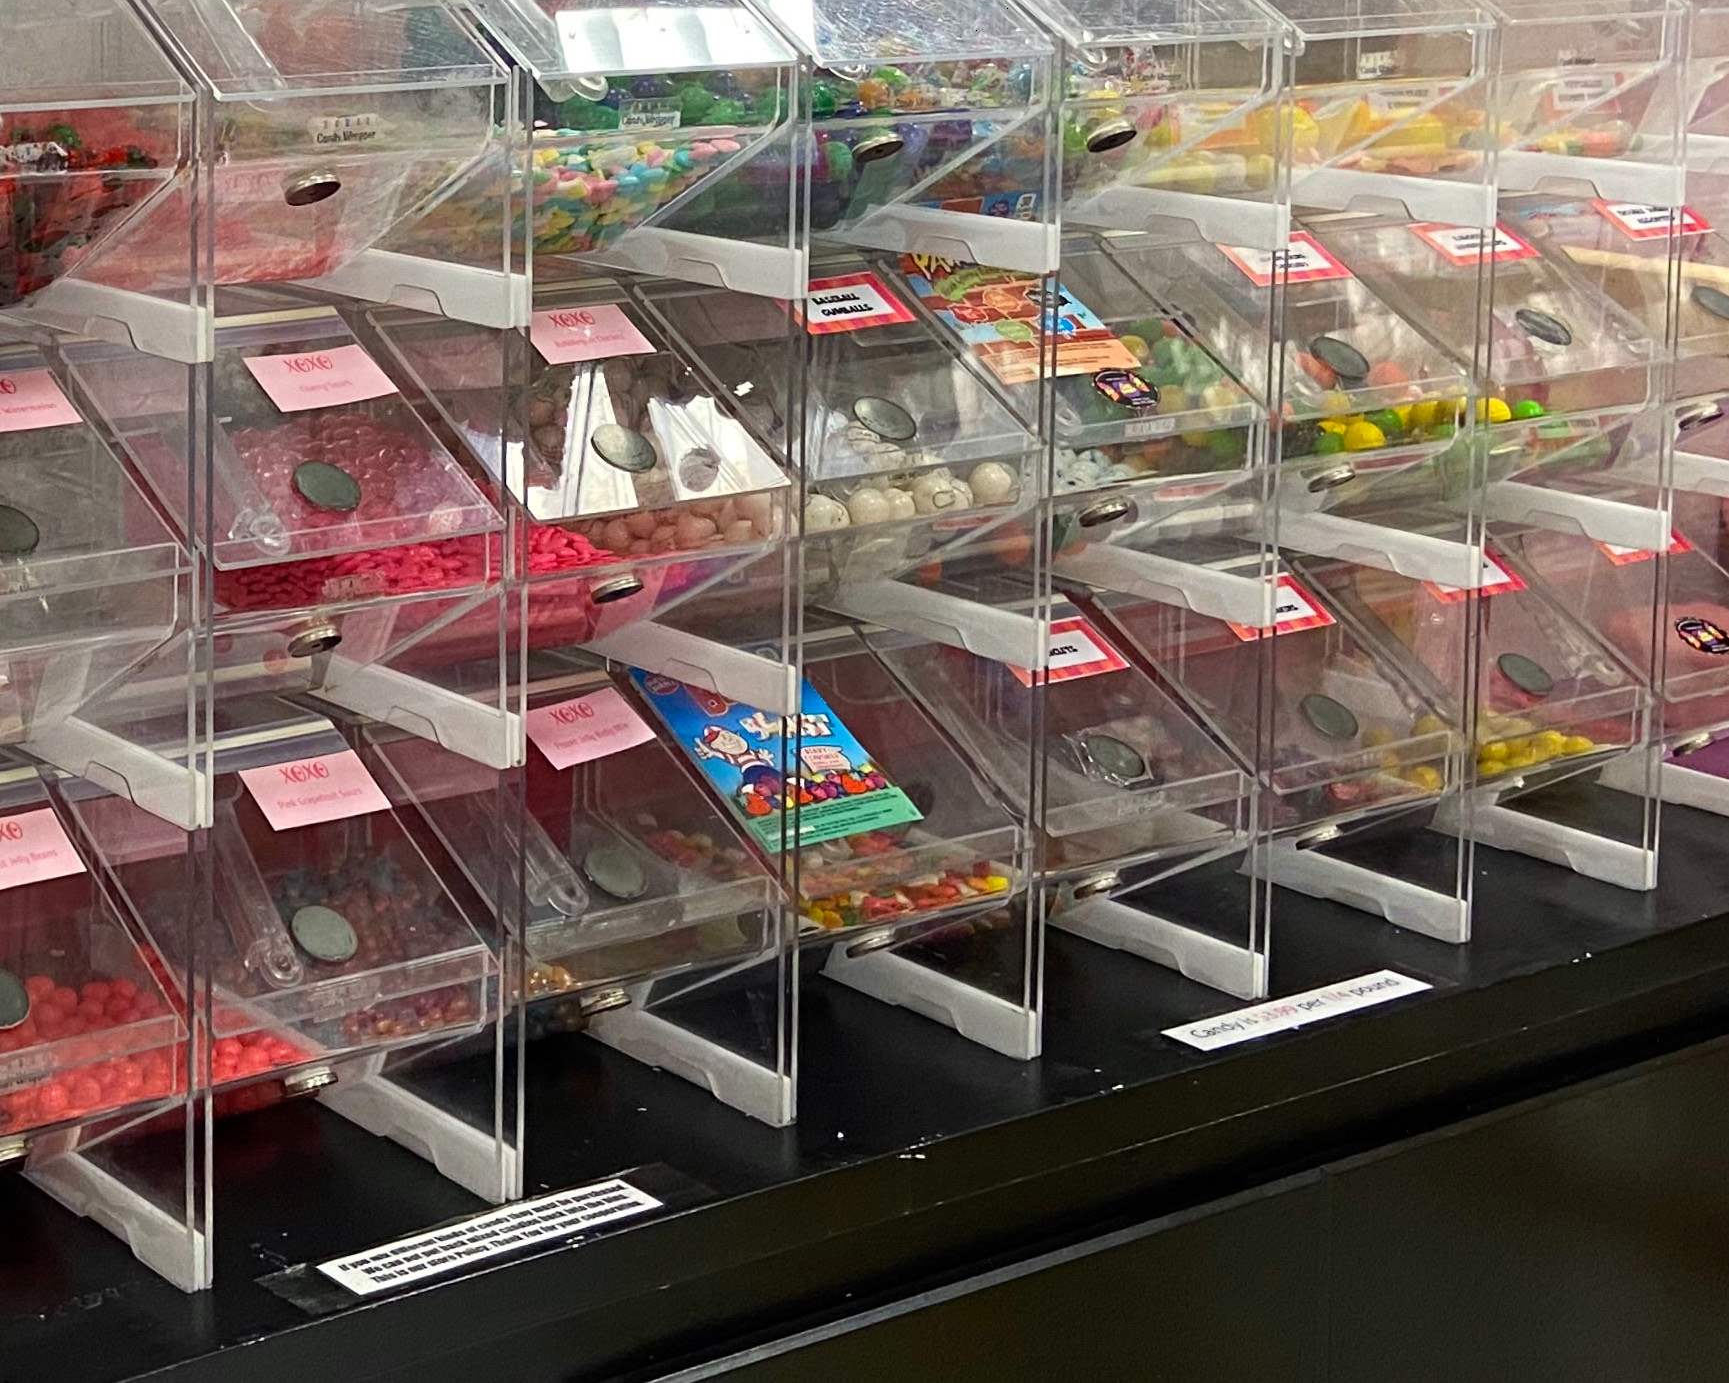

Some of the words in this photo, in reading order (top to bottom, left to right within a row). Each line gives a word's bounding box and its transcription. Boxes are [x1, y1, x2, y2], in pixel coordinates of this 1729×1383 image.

[10, 854, 30, 867] Jelly
[31, 848, 58, 862] Beans
[1190, 1022, 1245, 1038] Candy
[1298, 998, 1326, 1011] per
[1348, 978, 1400, 997] pound
[390, 1239, 437, 1255] different
[434, 1230, 467, 1241] kinds
[370, 1273, 398, 1283] This
